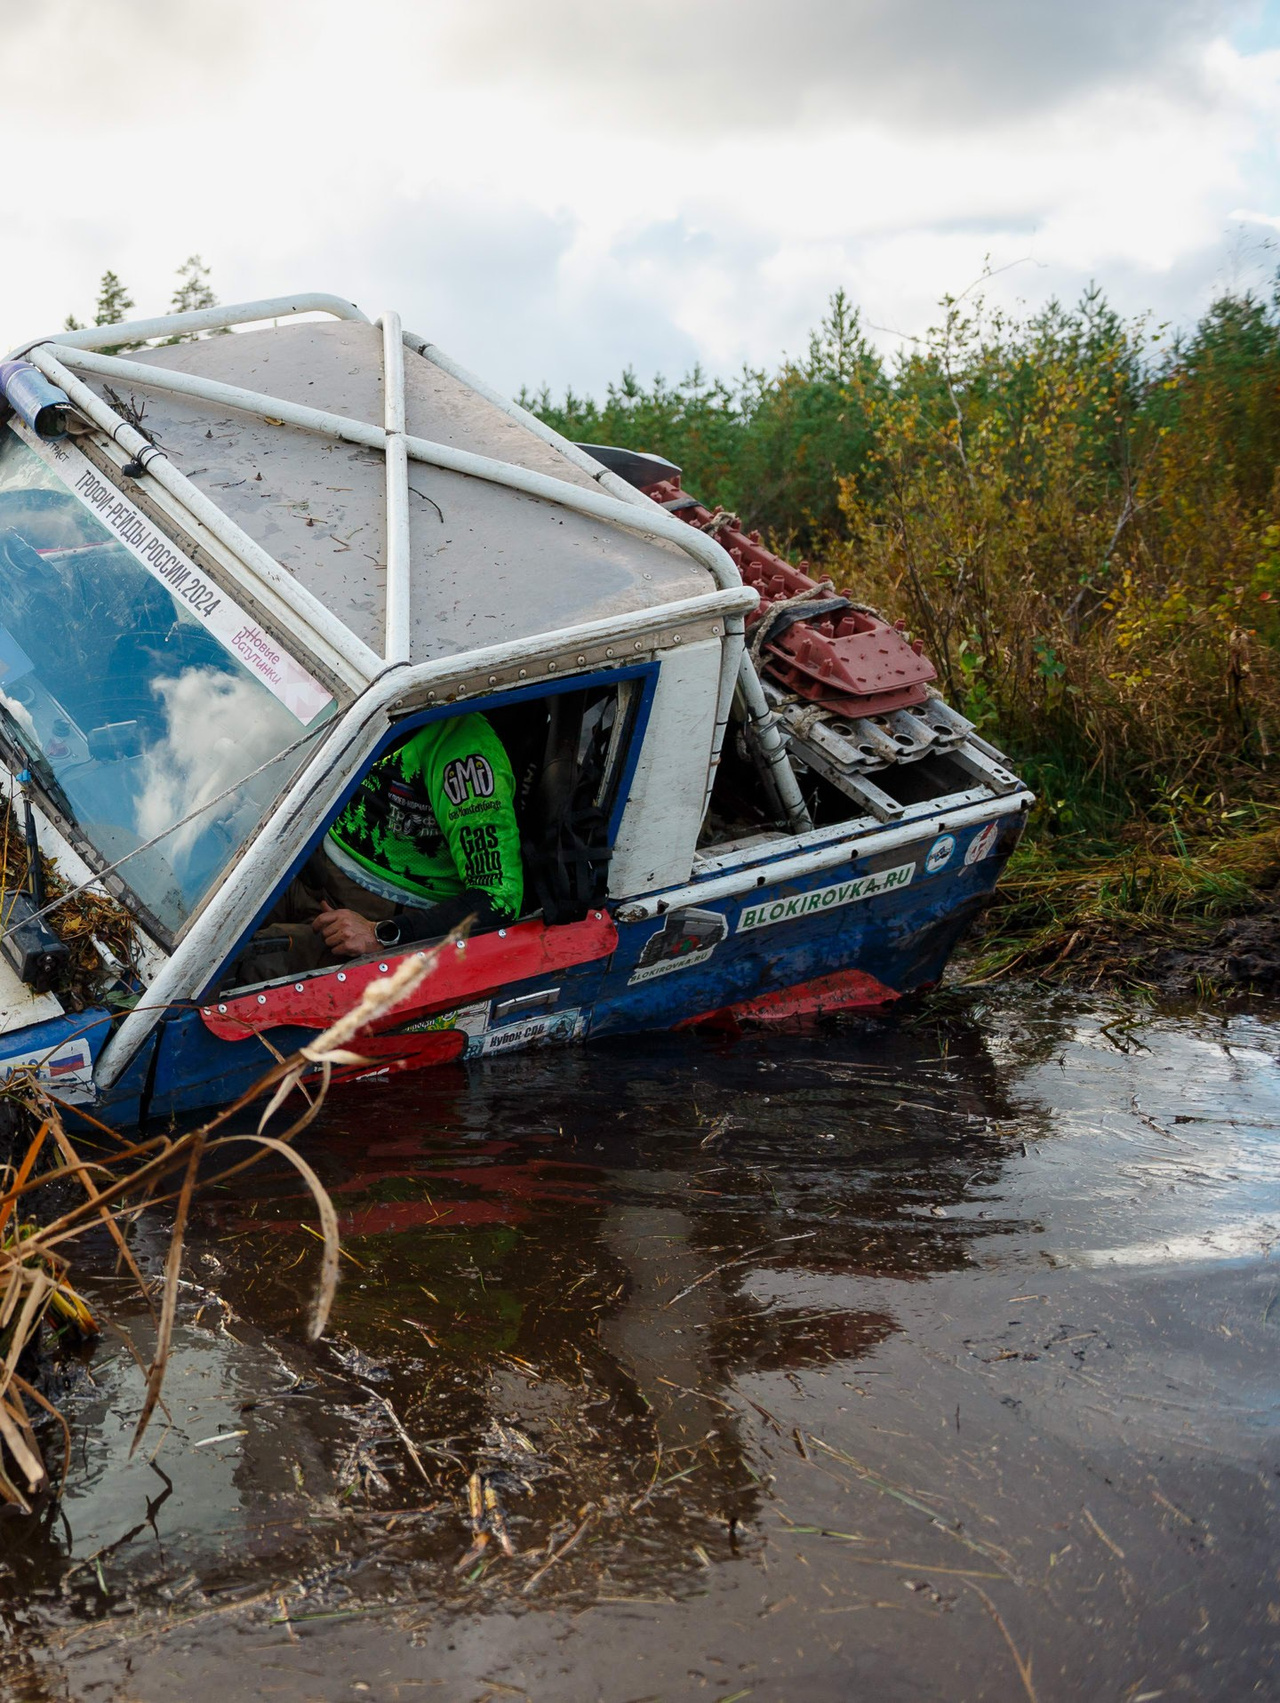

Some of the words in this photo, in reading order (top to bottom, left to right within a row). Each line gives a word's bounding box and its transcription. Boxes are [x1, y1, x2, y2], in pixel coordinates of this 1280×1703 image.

[460, 825, 499, 853] Gas
[742, 867, 911, 928] BLOKIROVKA.RU
[629, 952, 709, 983] BLOKIROVKA.RU
